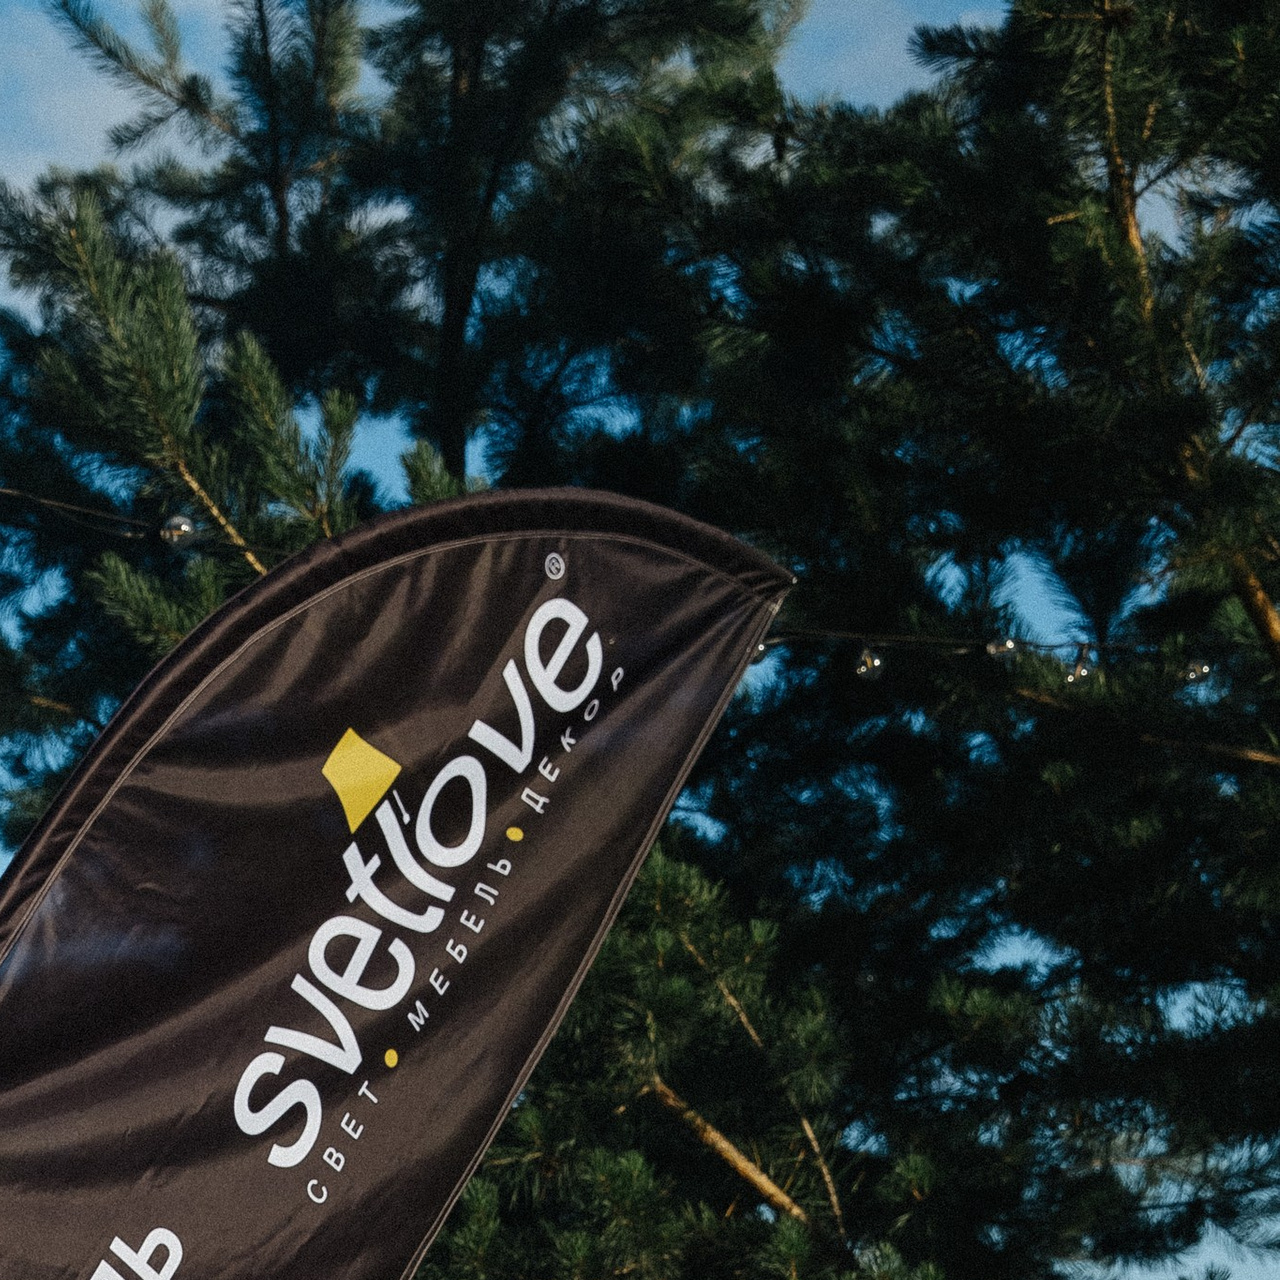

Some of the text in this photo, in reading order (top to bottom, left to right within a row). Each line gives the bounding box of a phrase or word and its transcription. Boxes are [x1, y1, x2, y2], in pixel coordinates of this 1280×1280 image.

[233, 598, 603, 1169] svetlove
[306, 666, 624, 1204] СВЕТ МЕБЕЛЬ ДЕКОР
